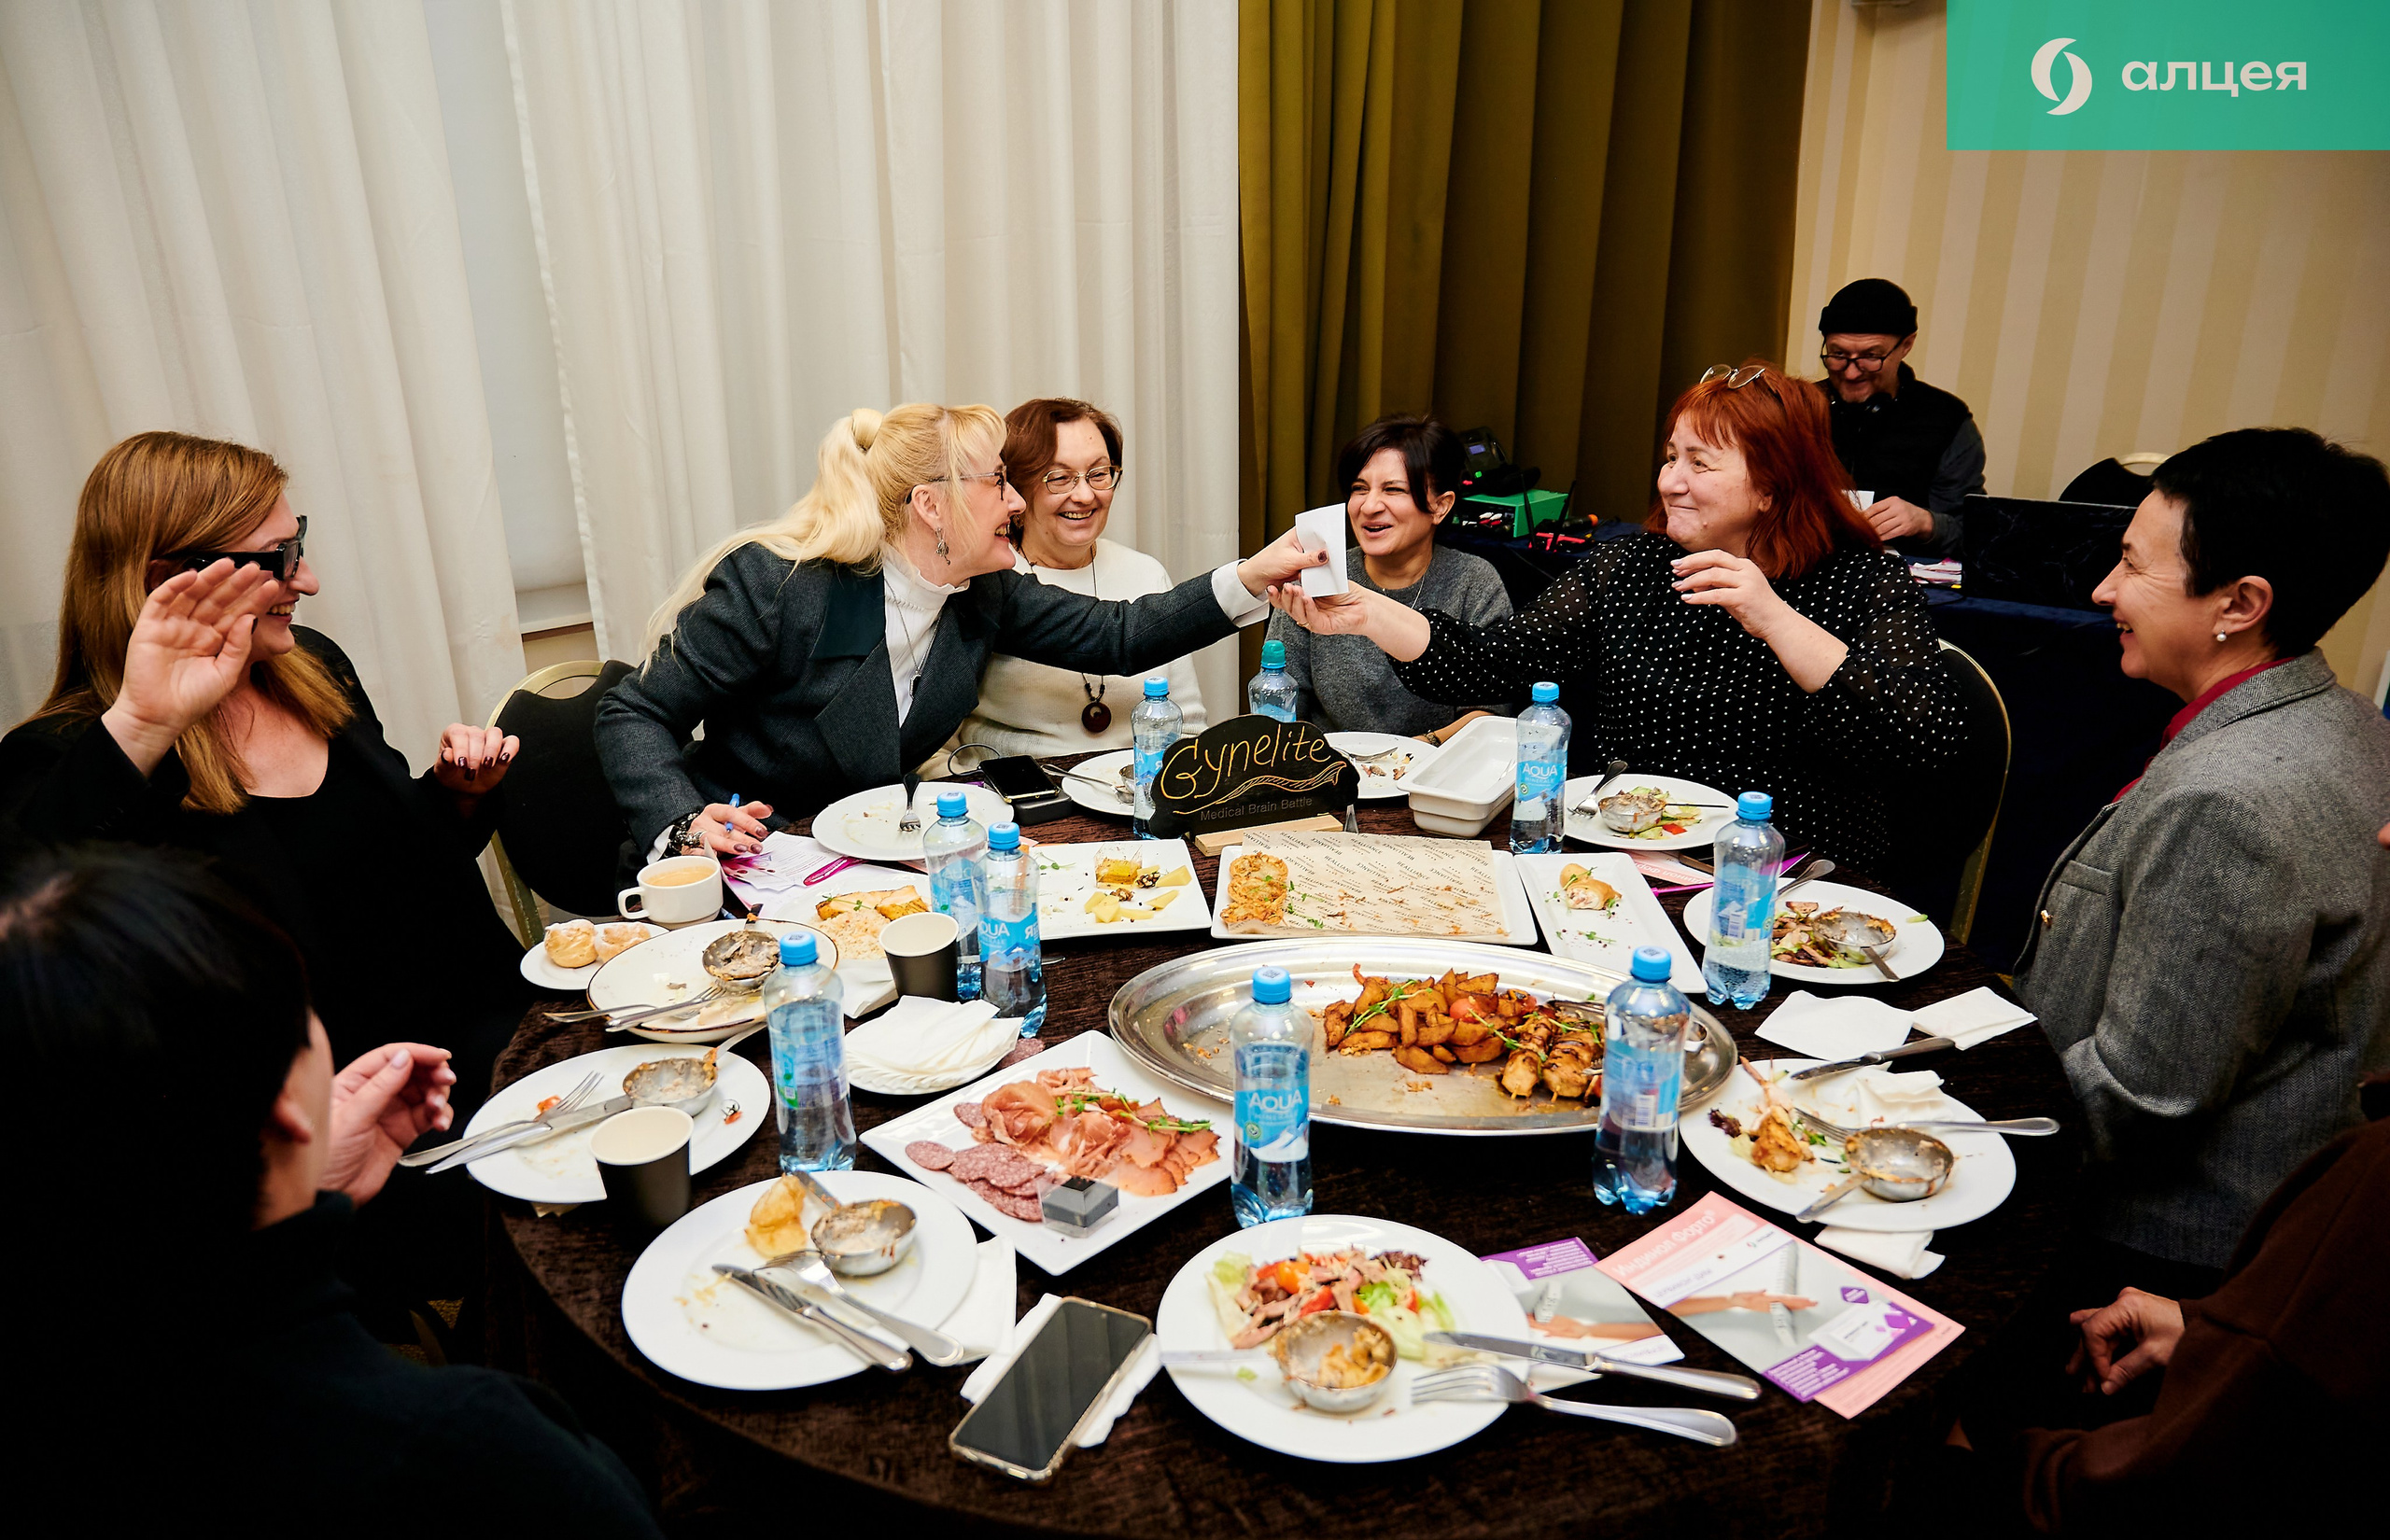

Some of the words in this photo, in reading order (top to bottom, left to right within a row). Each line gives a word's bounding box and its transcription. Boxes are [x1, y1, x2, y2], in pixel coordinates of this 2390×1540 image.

[1160, 723, 1331, 800] Gynelite
[1523, 763, 1558, 779] AQUA
[1201, 805, 1244, 821] Medical
[1249, 801, 1277, 815] Brain
[1281, 796, 1313, 810] Battle
[978, 919, 1011, 939] QUA
[1249, 1089, 1303, 1113] AQUA
[1611, 1240, 1677, 1278] Индинол
